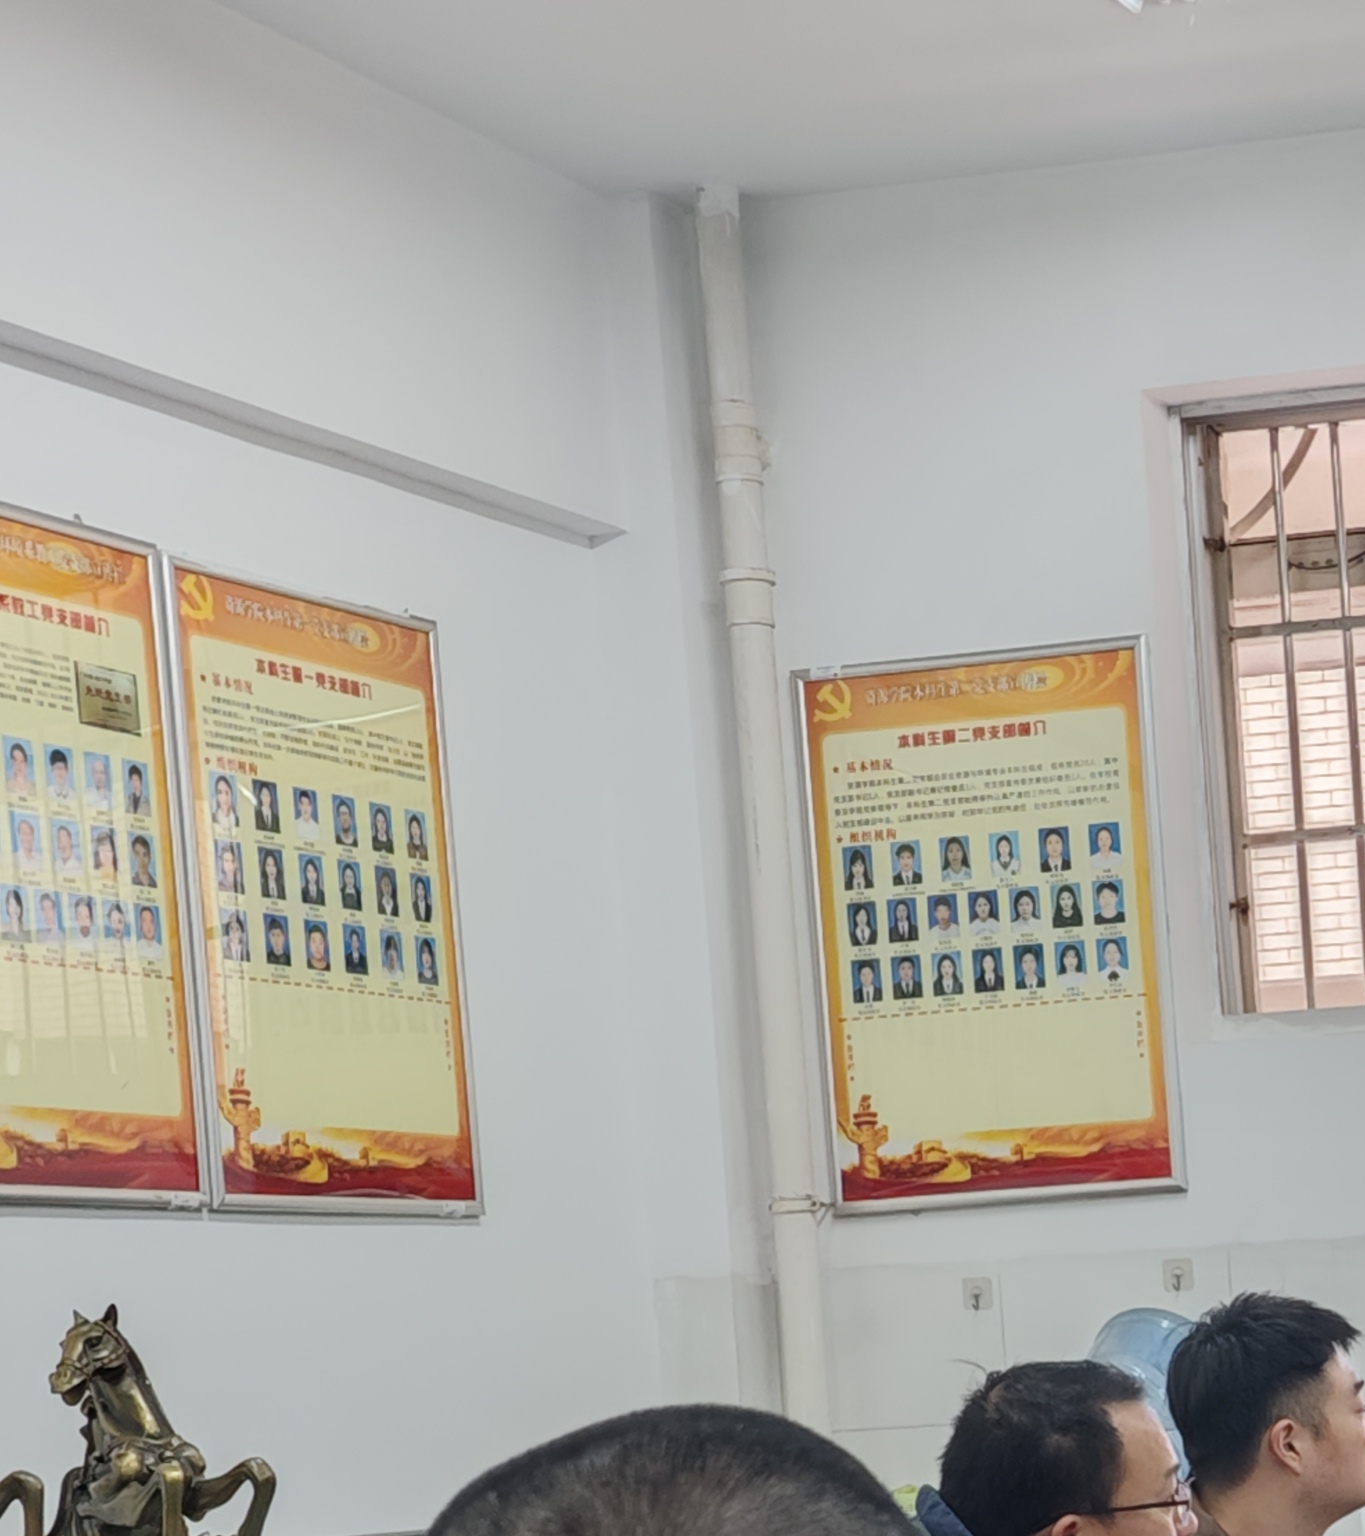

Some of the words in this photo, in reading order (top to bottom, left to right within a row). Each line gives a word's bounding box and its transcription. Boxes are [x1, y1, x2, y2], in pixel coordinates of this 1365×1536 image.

[897, 720, 1047, 749] 本科生第二党支部简介
[846, 758, 894, 774] 基本情况
[849, 828, 897, 843] 组织机构
